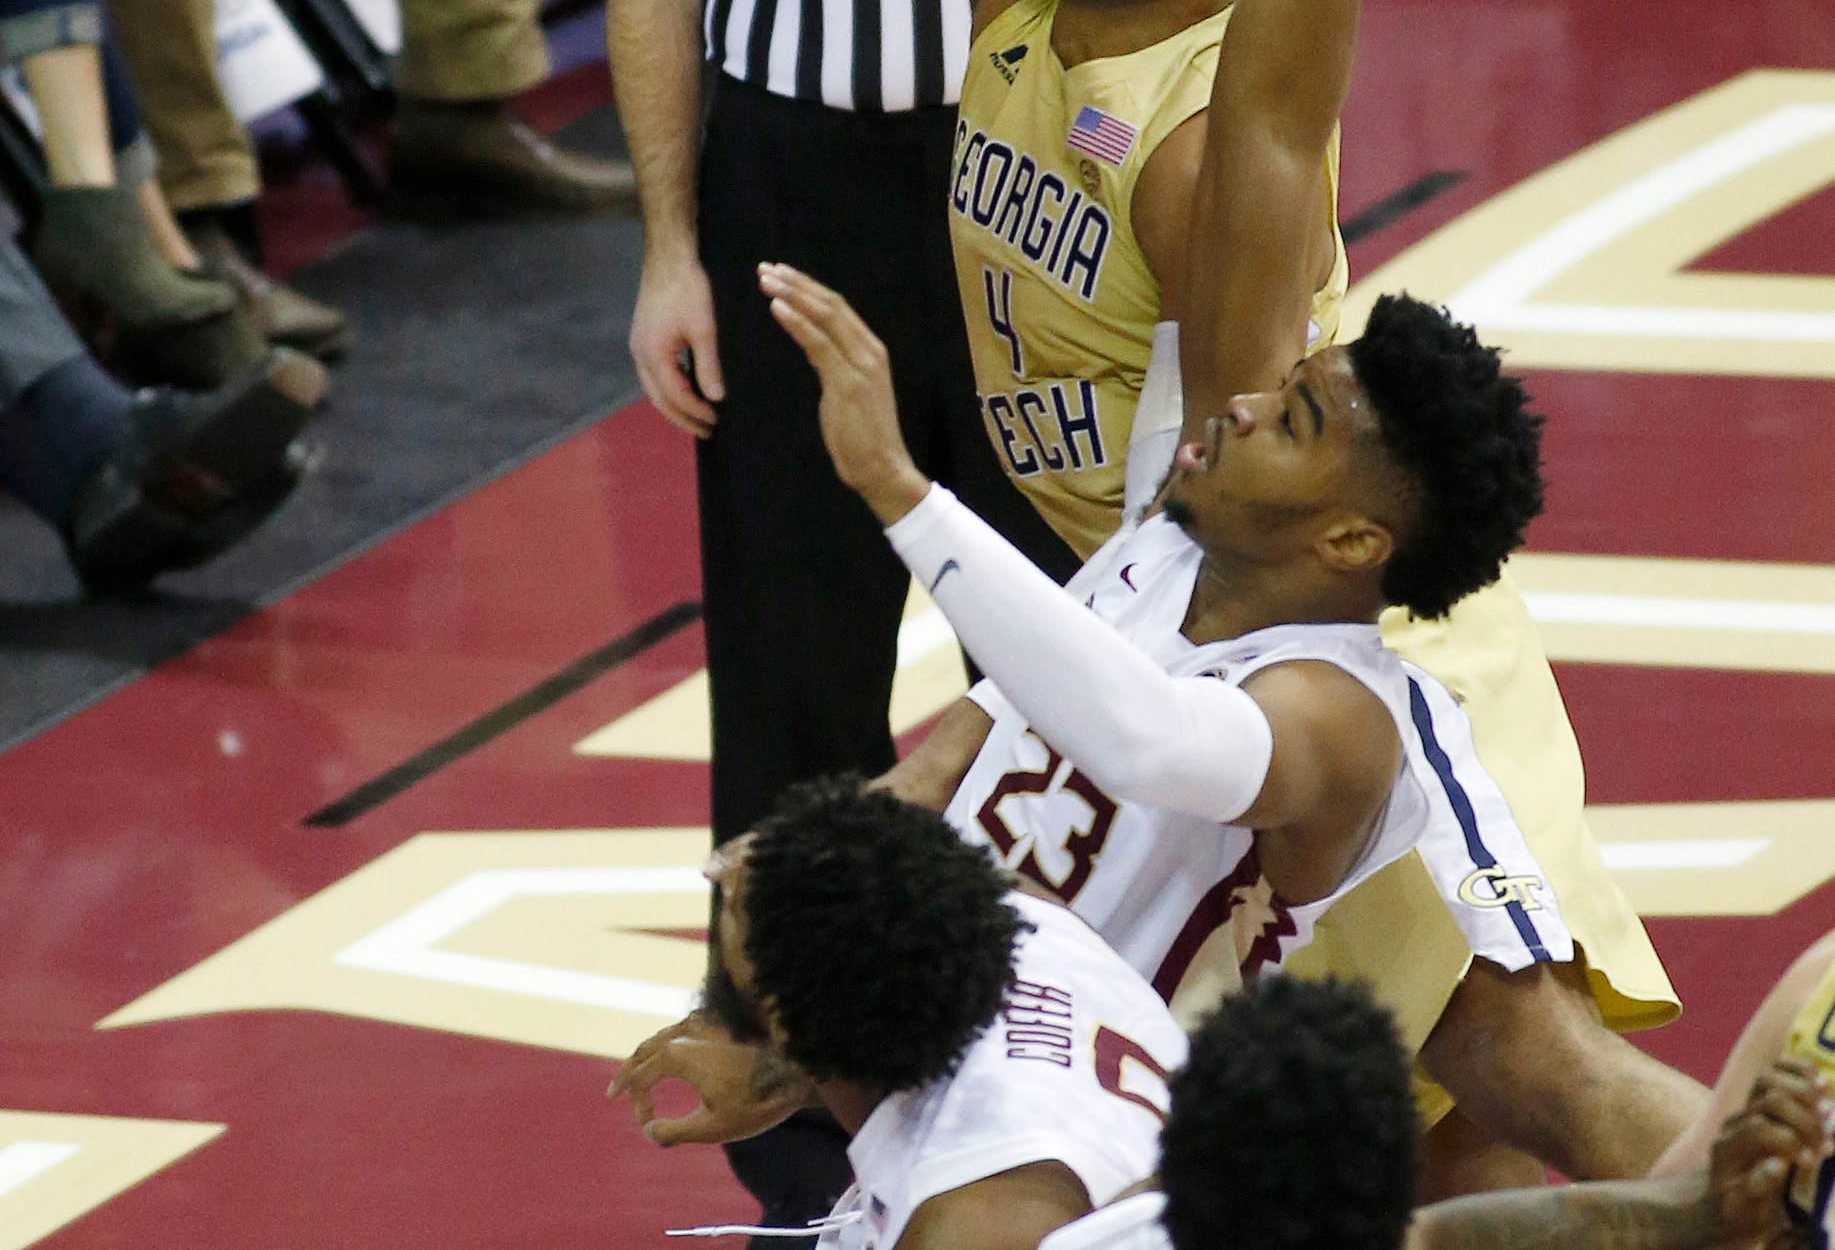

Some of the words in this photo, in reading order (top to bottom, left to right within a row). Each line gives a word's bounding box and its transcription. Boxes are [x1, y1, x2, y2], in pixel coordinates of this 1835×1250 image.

[983, 267, 1025, 378] 4
[975, 380, 1107, 478] ECH
[977, 725, 1120, 903] 23
[1458, 863, 1542, 911] GT
